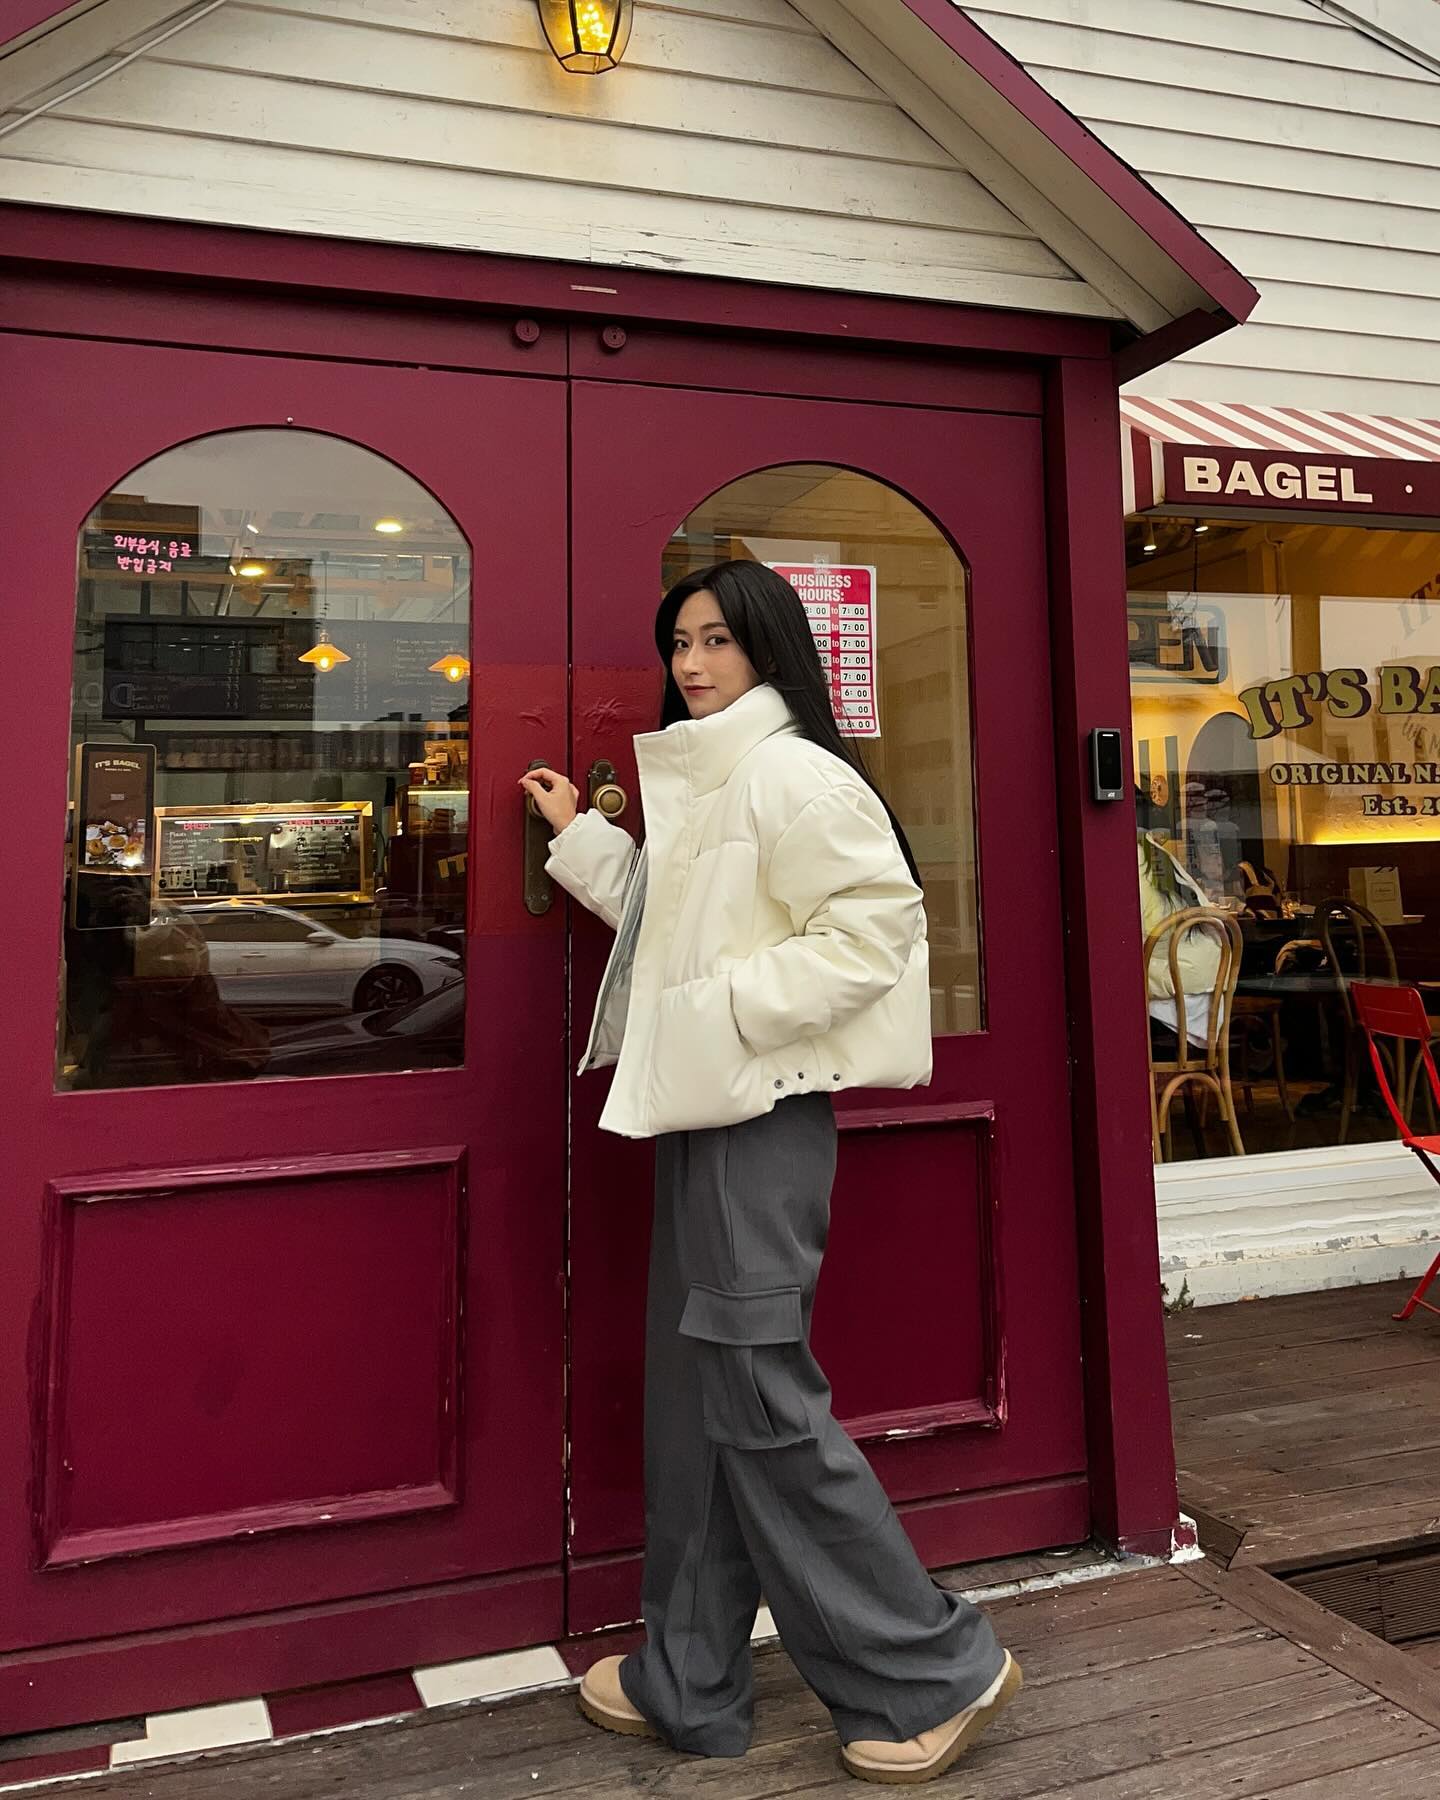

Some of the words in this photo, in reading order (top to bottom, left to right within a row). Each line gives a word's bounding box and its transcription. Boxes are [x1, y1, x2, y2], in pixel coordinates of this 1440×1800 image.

[1183, 456, 1374, 504] BAGEL
[114, 535, 160, 556] 외부음식
[790, 573, 852, 588] BUSINESS
[798, 588, 845, 602] HOURS:
[831, 606, 839, 615] to
[831, 622, 839, 631] to
[832, 639, 840, 648] to
[832, 655, 840, 664] to
[832, 672, 840, 681] to
[833, 688, 841, 697] to
[1238, 668, 1371, 740] IT'S
[1270, 763, 1411, 785] ORIGINAL
[1363, 794, 1416, 816] Est.
